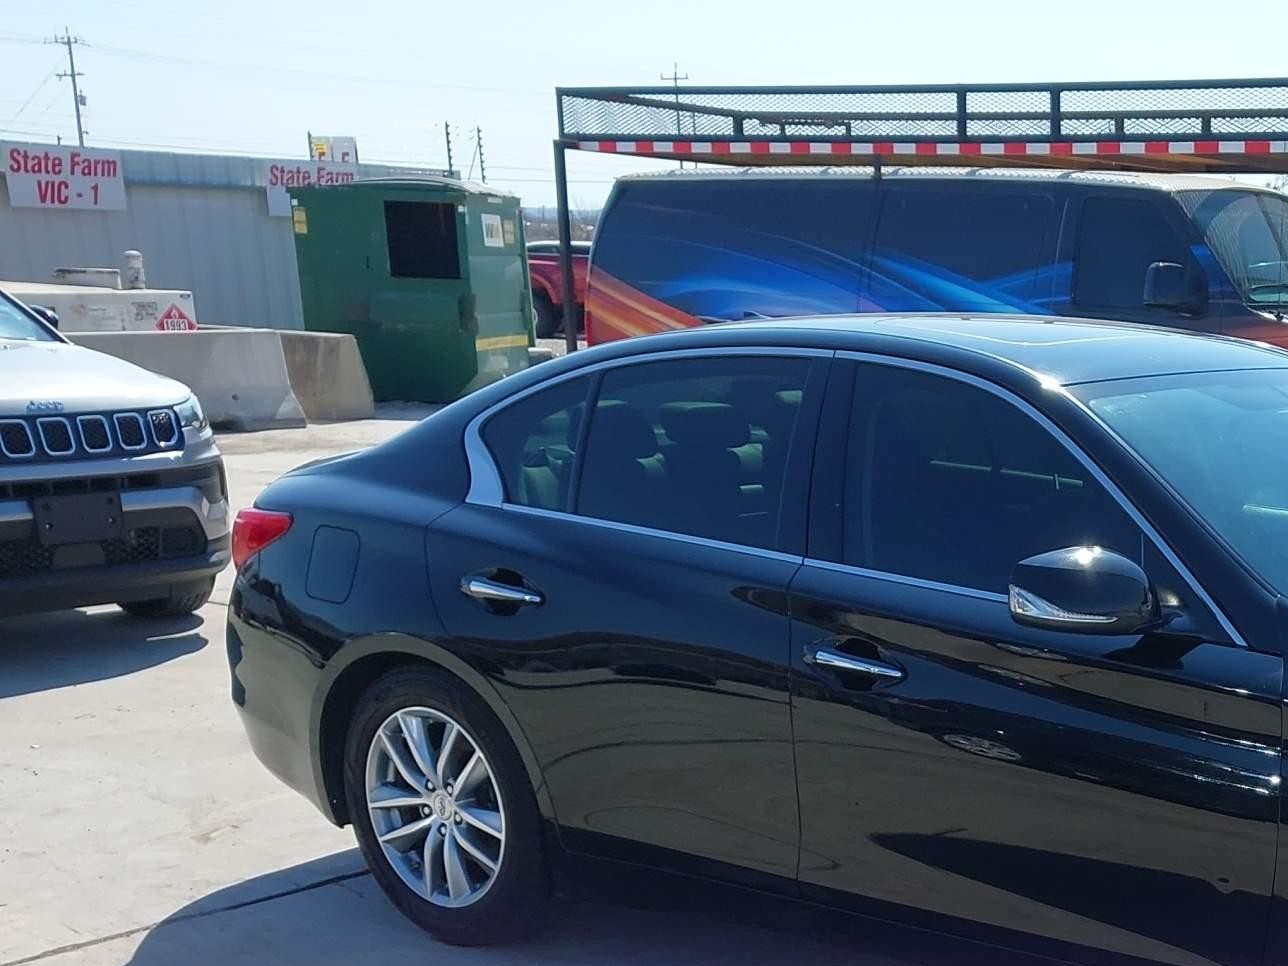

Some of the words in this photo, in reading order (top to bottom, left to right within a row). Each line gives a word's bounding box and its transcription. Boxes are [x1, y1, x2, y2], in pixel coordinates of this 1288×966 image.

[9, 147, 63, 176] State
[70, 151, 117, 177] Farm
[269, 163, 311, 187] State
[316, 166, 354, 186] Farm
[36, 180, 69, 205] VIC
[90, 182, 99, 206] 1
[164, 320, 188, 331] 1993
[27, 400, 64, 411] Jeep
